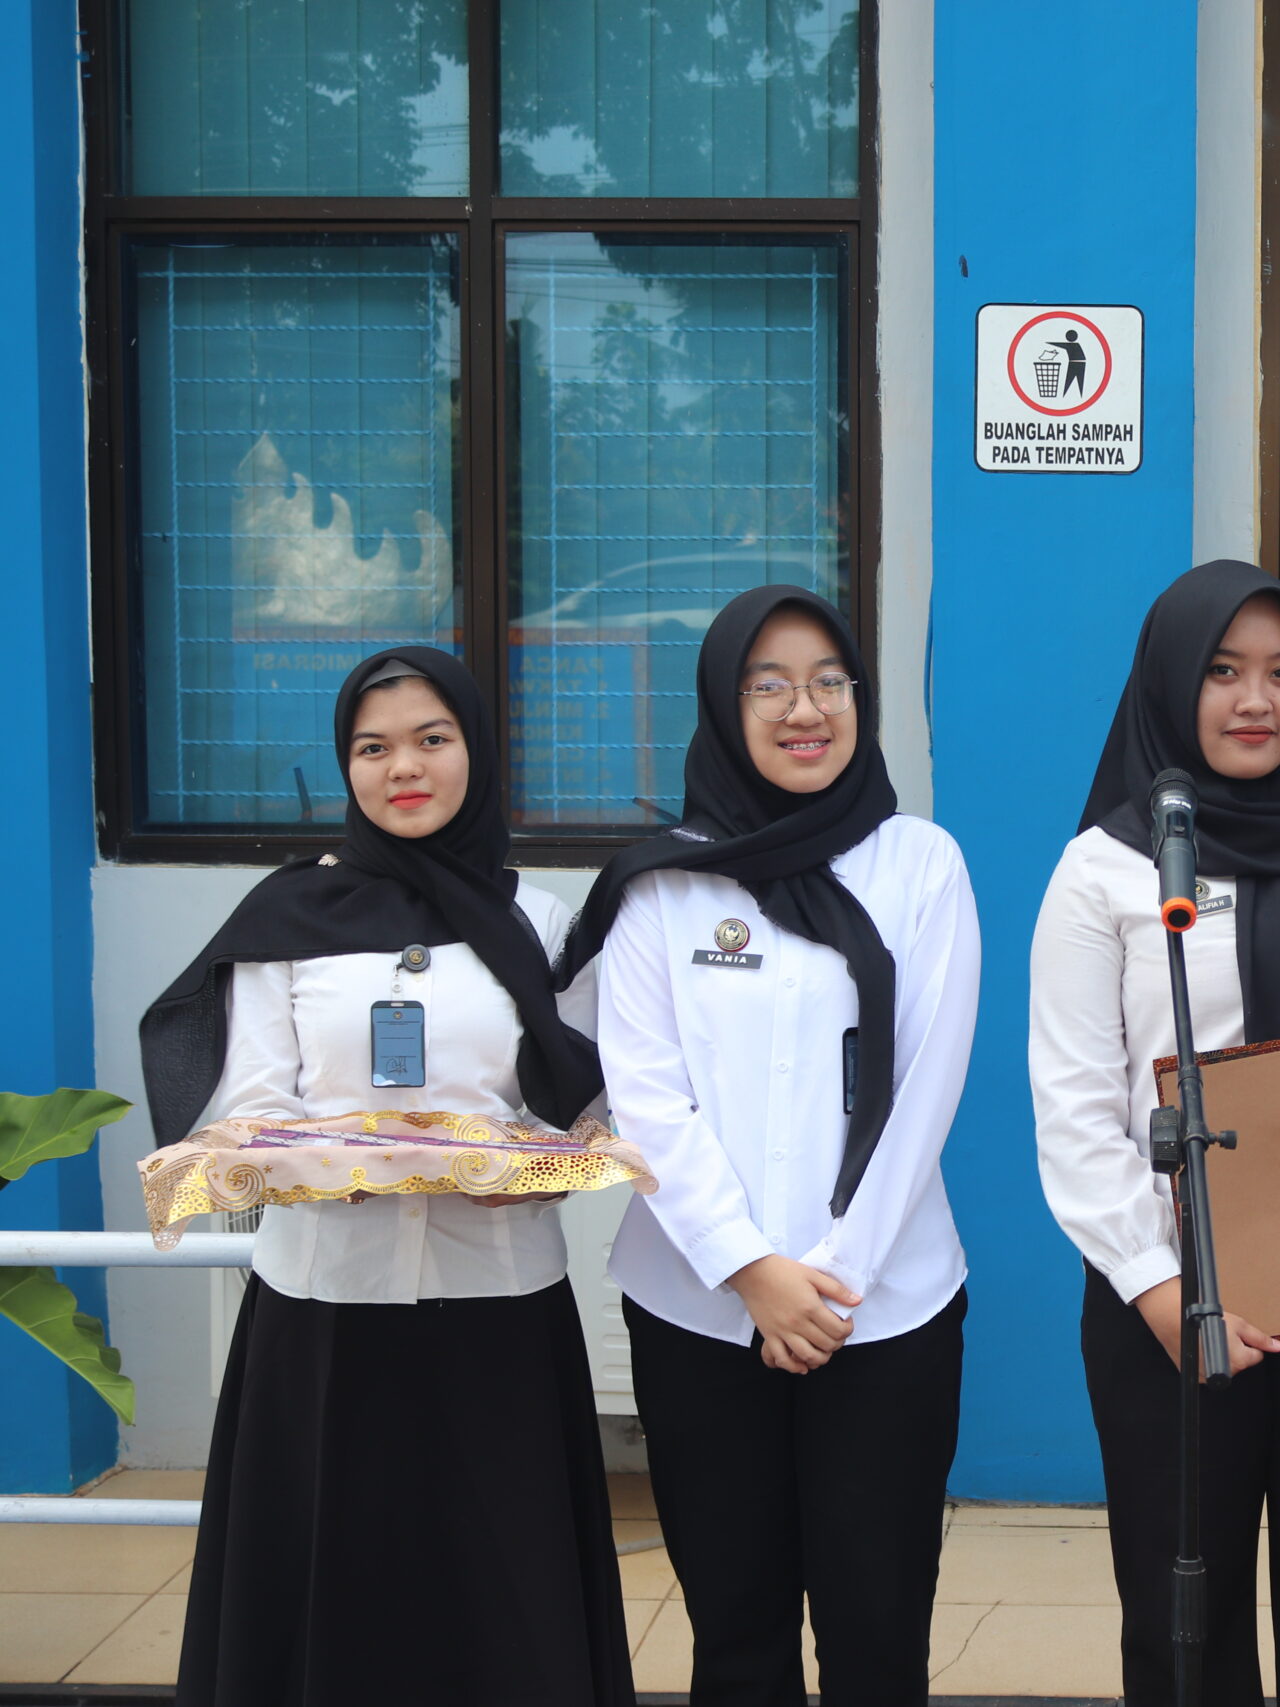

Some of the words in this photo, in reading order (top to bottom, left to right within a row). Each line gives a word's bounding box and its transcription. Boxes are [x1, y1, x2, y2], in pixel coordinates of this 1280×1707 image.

[984, 422, 1067, 441] BUANGLAH
[1071, 423, 1134, 442] SAMPAH
[992, 446, 1031, 464] PADA
[1035, 447, 1125, 465] TEMPATNYA
[707, 953, 747, 964] VANIA
